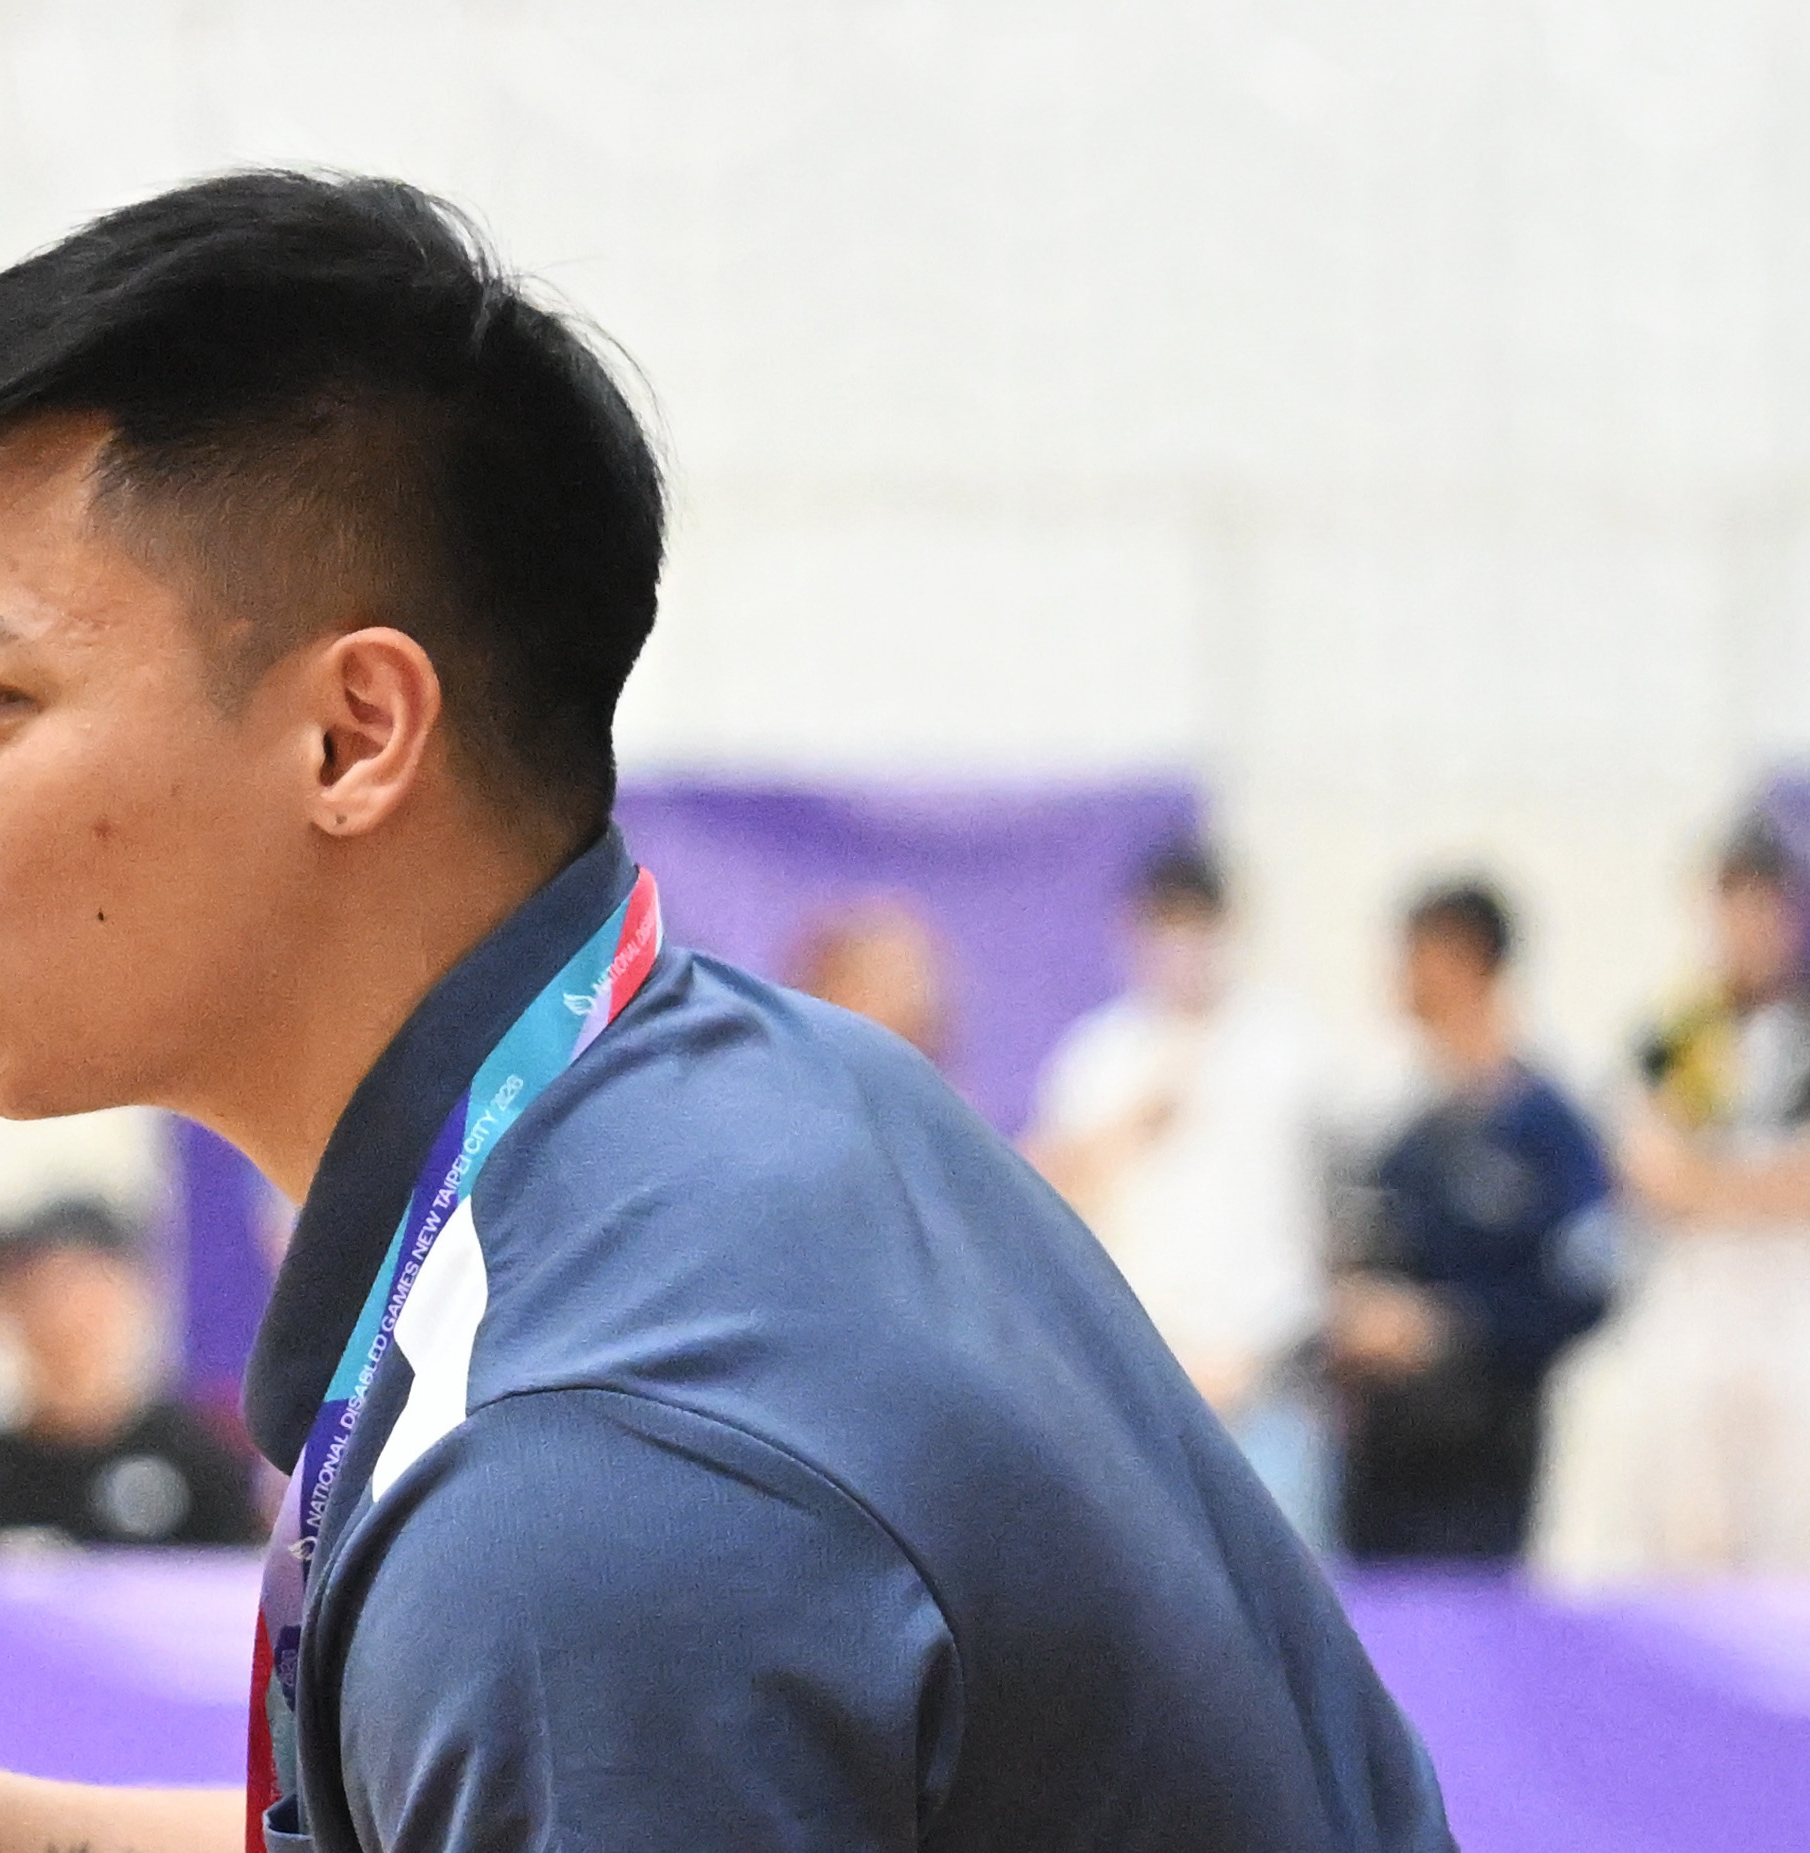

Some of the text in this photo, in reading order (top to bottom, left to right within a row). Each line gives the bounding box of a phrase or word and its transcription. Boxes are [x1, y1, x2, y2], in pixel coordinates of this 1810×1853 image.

[306, 1434, 349, 1527] NATIONAL
[340, 1333, 388, 1430] DISABLED
[381, 1260, 420, 1333] GAMES
[411, 1210, 443, 1261] NEW
[432, 1153, 472, 1209] TAIPEI
[463, 1109, 499, 1155] CITY
